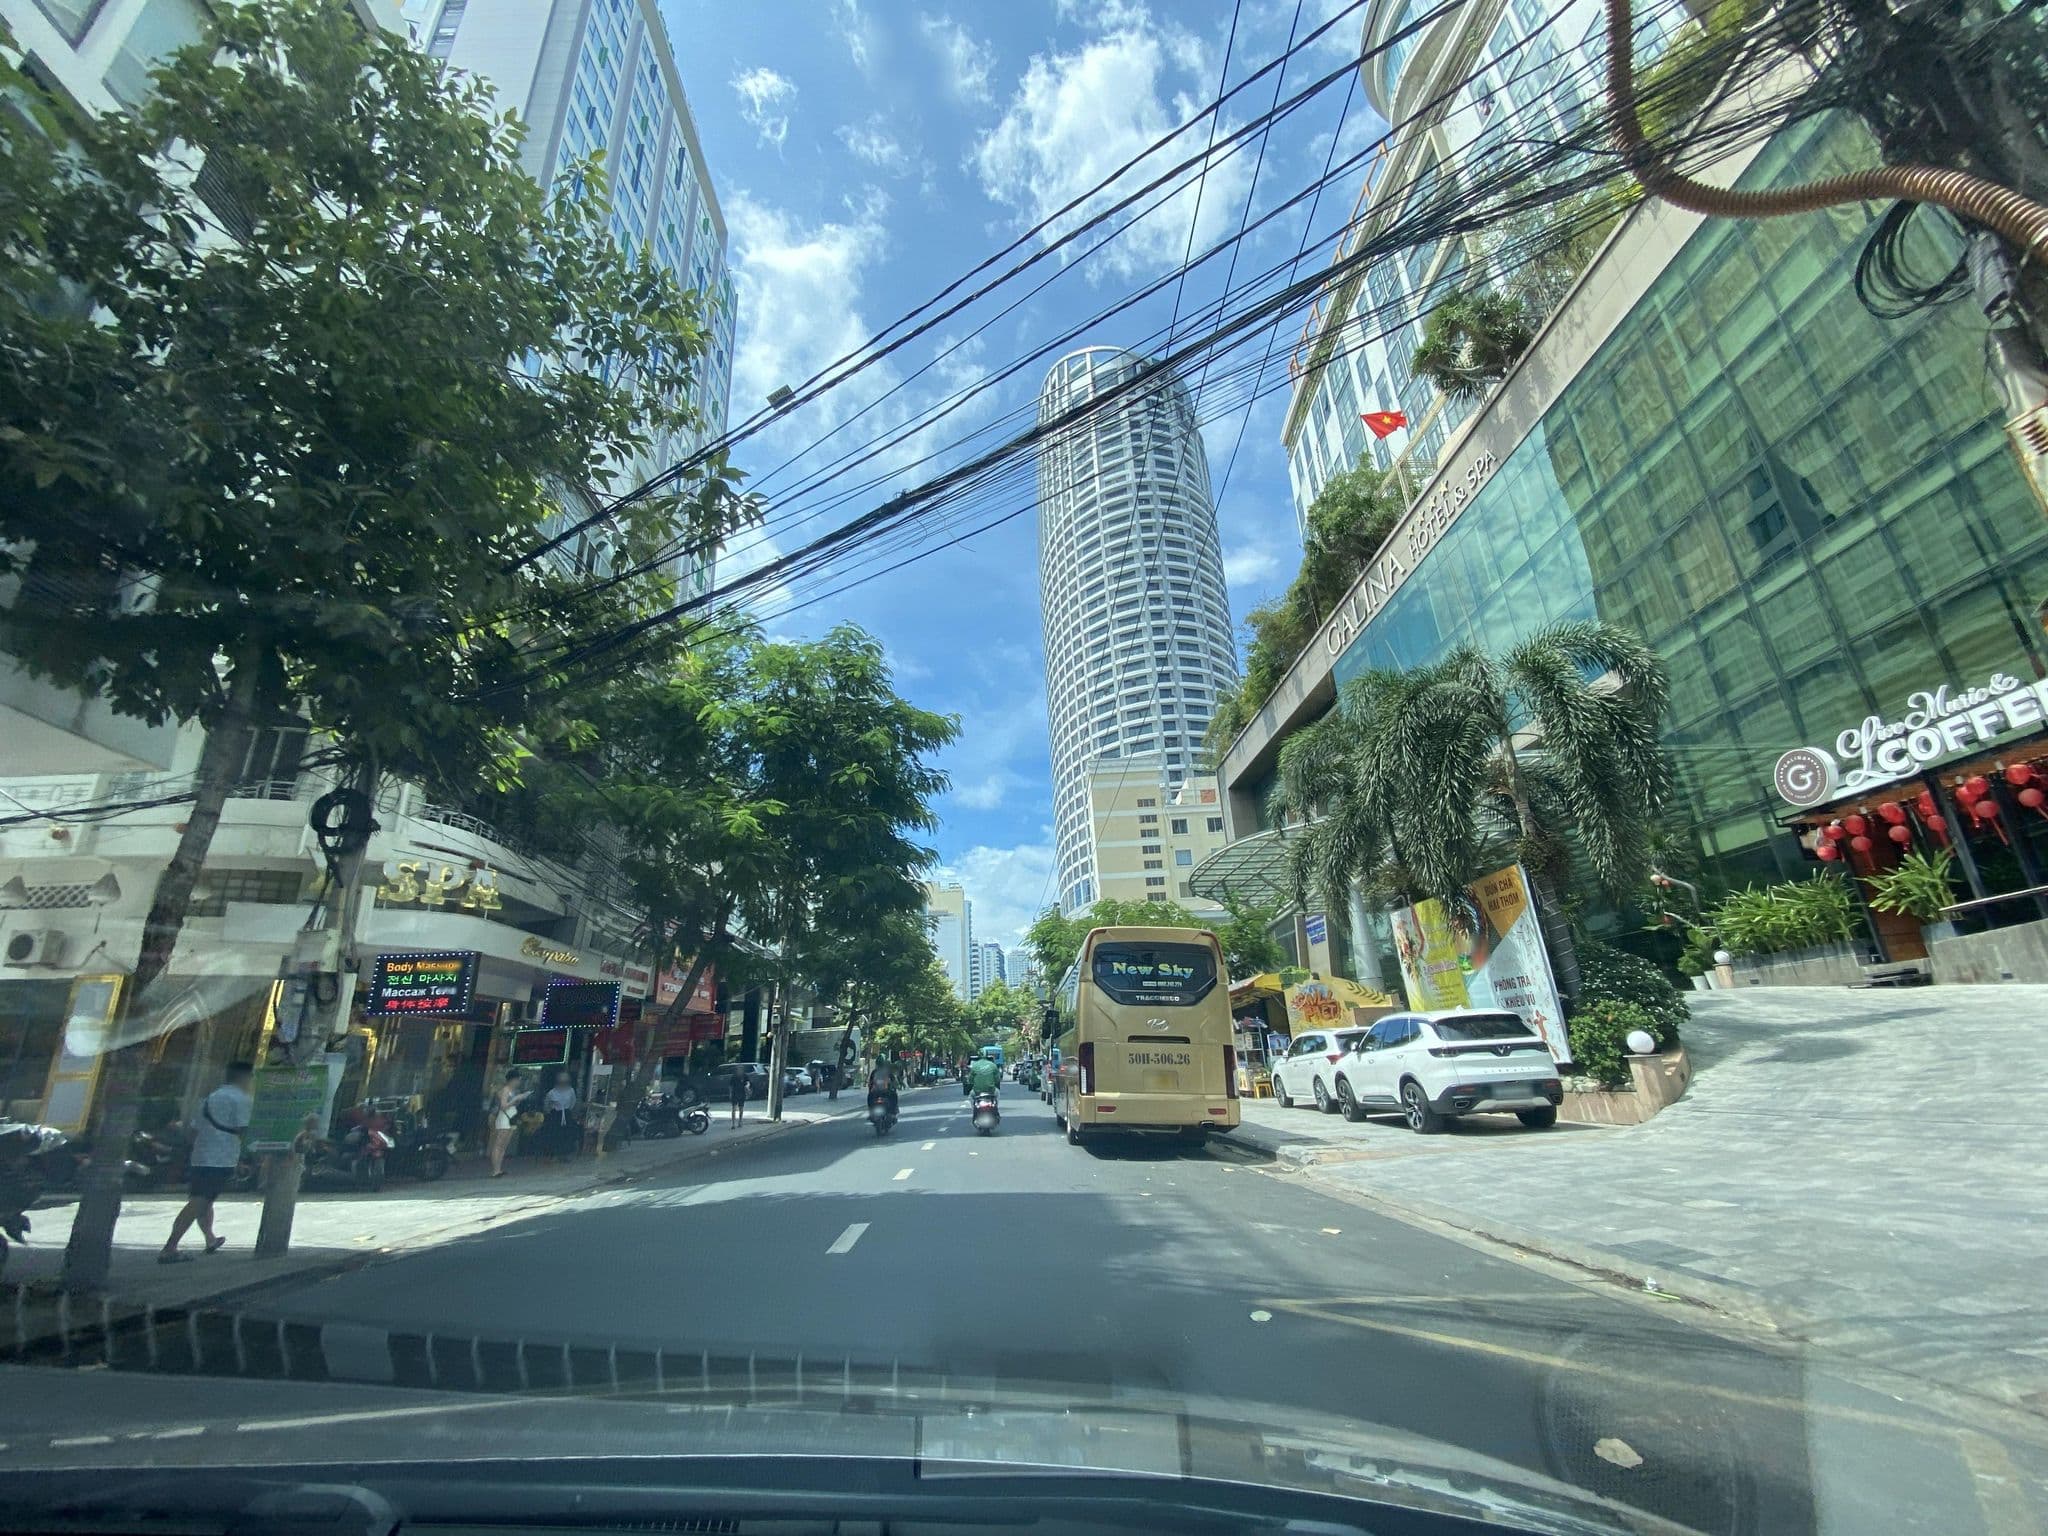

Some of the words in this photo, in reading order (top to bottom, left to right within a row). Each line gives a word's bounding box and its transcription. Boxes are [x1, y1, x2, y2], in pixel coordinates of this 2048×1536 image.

[1326, 551, 1407, 656] GALINA
[1407, 503, 1456, 562] HOTEL
[1454, 486, 1468, 506] &
[1466, 449, 1498, 490] SPA
[1836, 715, 1918, 787] Live
[1904, 684, 1990, 730] Music
[377, 859, 502, 910] SPA
[386, 962, 414, 974] Body
[1112, 962, 1154, 975] New
[1158, 963, 1194, 979] Sky
[386, 974, 414, 985] 전신
[419, 973, 457, 984] 마사지
[381, 986, 428, 998] Массаж
[1128, 1053, 1190, 1065] 50H-506.26
